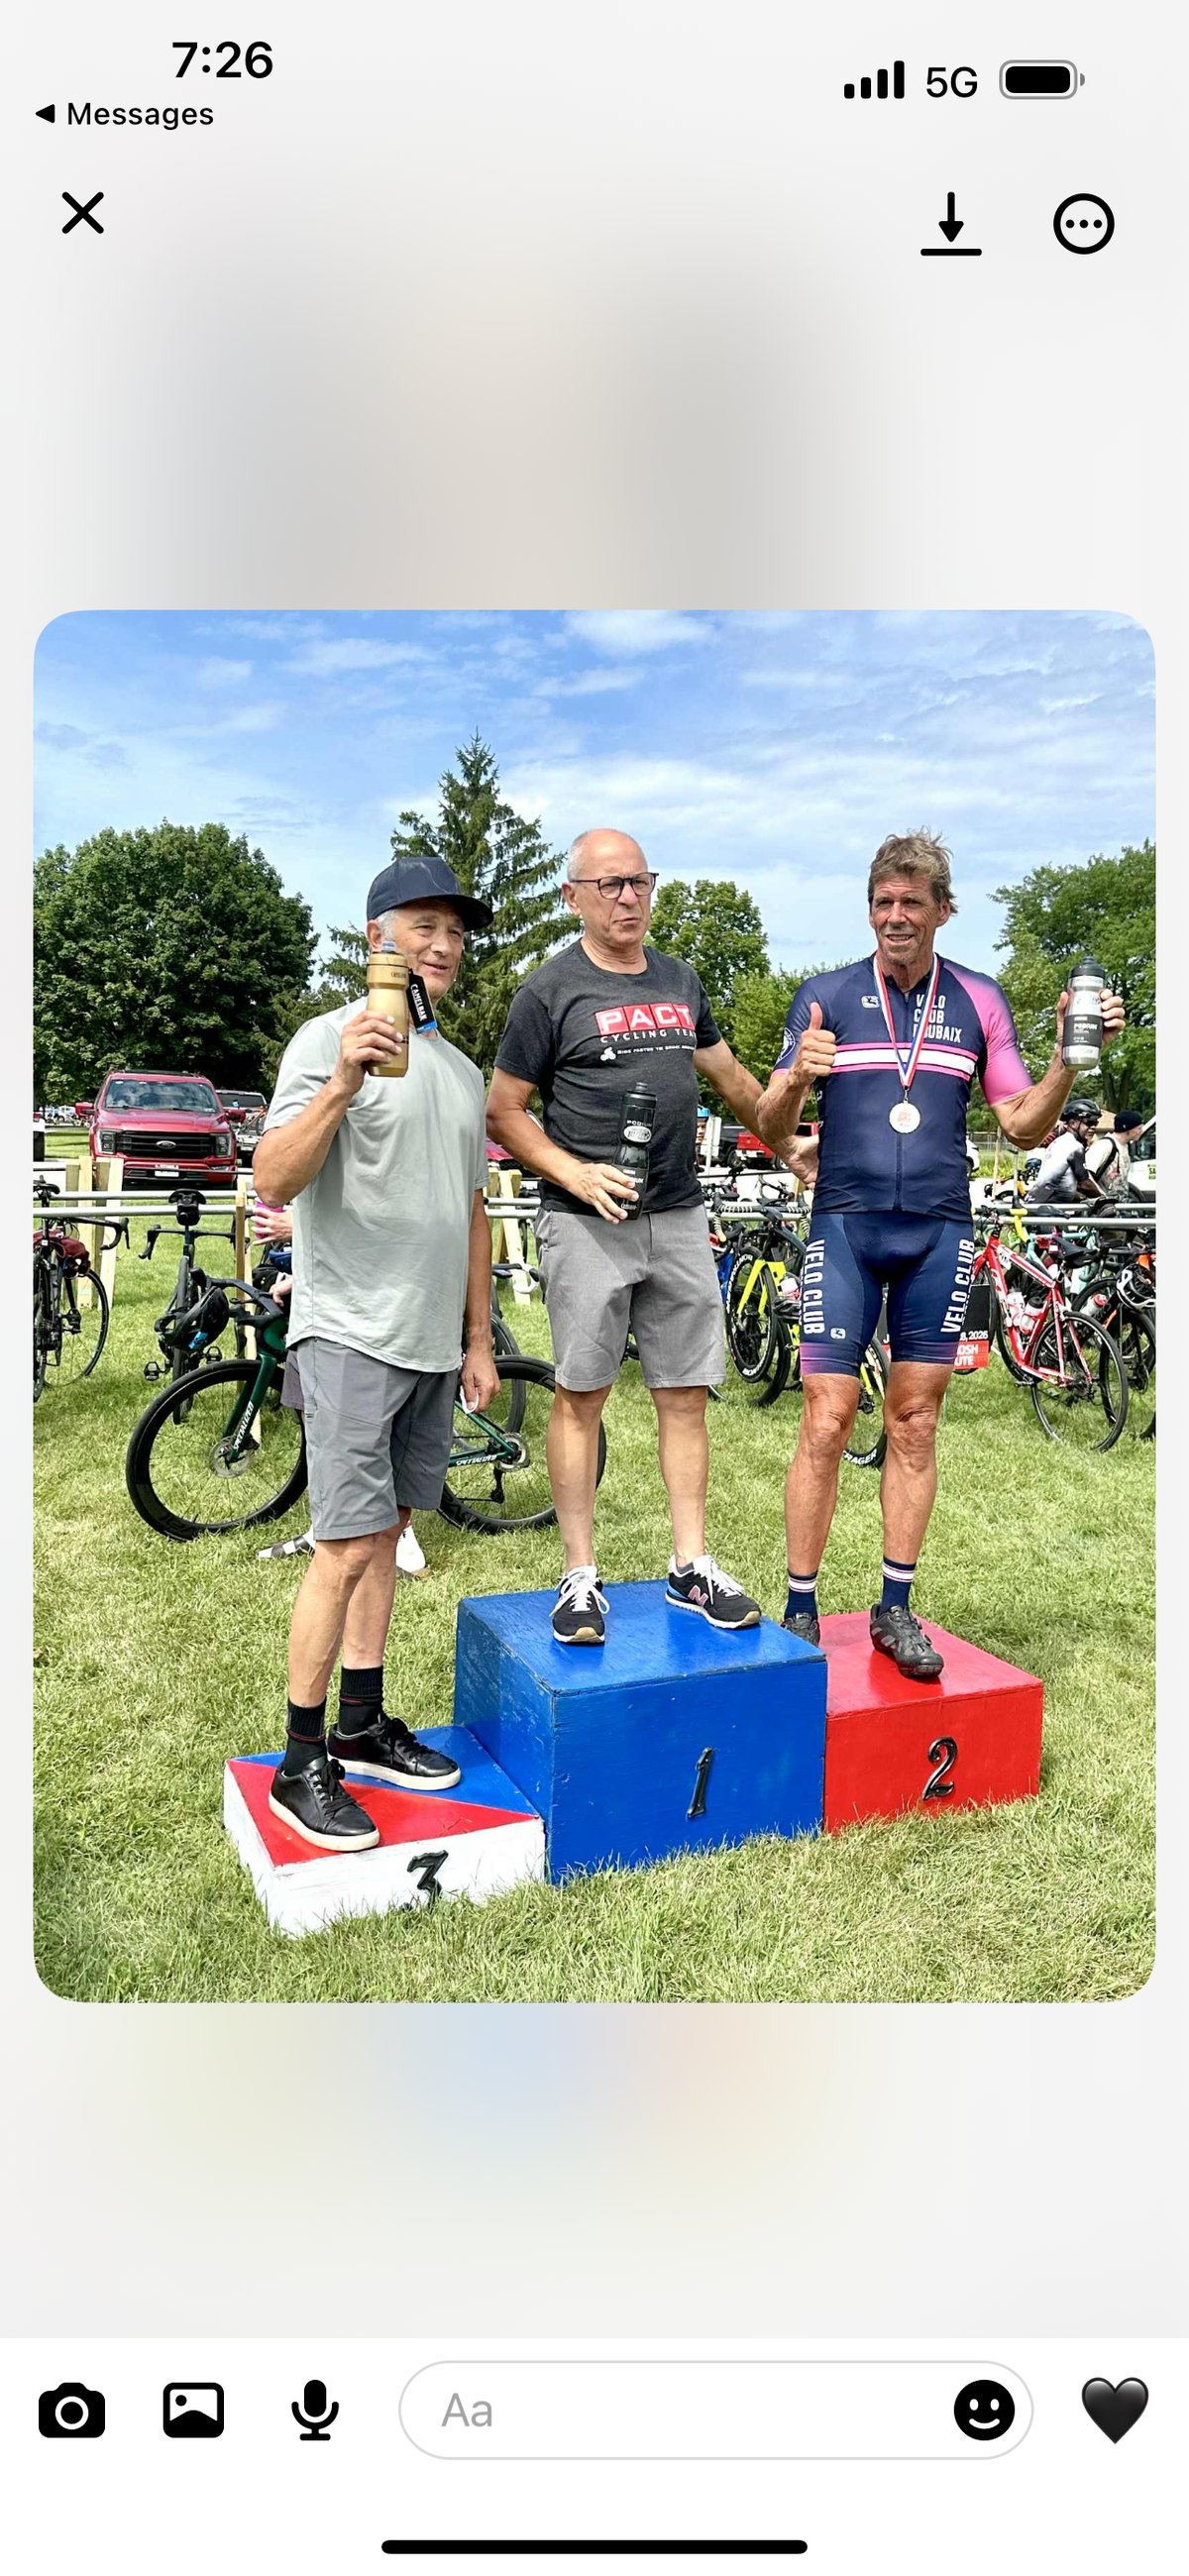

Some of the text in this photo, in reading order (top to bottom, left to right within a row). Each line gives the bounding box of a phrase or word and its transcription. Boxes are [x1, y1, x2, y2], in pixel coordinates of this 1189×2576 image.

[599, 1005, 692, 1035] PACT
[914, 1009, 944, 1023] CUB
[916, 994, 946, 1010] VLO
[599, 1029, 668, 1043] CYCLING
[803, 1238, 824, 1335] VELO CLUB
[940, 1290, 968, 1333] VELO
[954, 1238, 975, 1286] CLUB
[968, 1330, 989, 1341] 2026
[687, 1747, 714, 1819] 1
[922, 1736, 958, 1801] 2
[399, 1850, 450, 1915] 3
